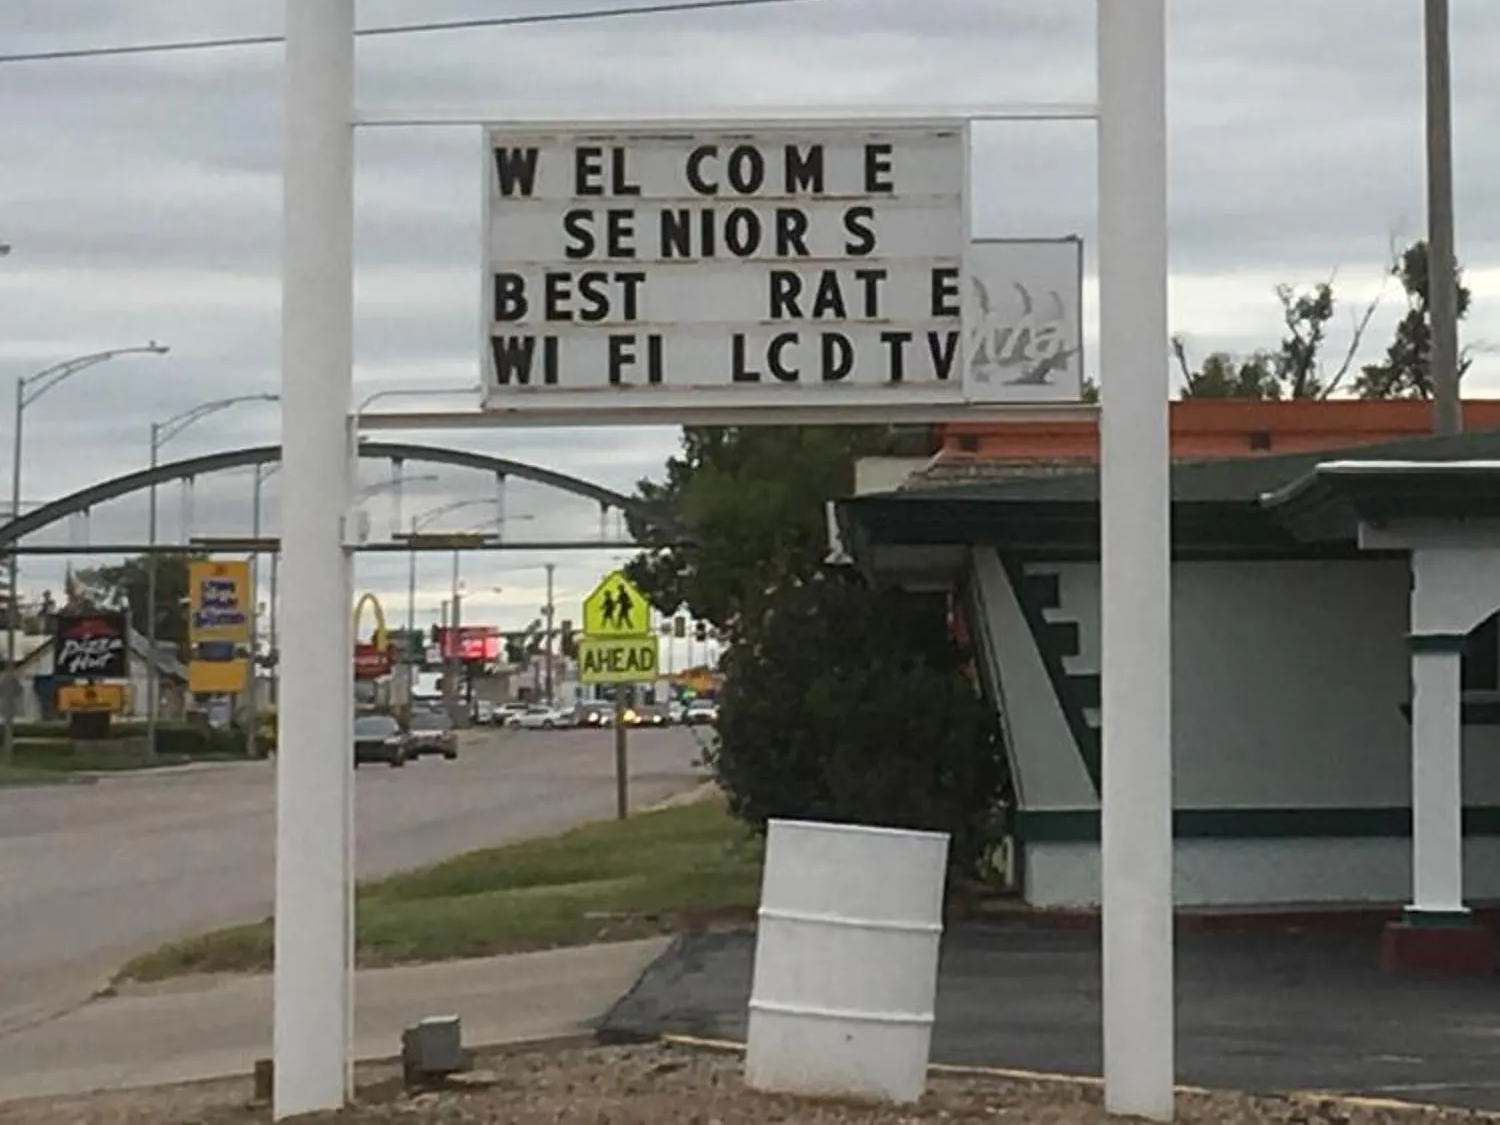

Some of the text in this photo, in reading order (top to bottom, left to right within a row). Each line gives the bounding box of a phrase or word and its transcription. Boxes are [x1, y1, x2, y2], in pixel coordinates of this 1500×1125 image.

[494, 143, 895, 196] WELCOME
[563, 206, 877, 259] SENIORS
[493, 267, 961, 323] BEST RATE
[582, 646, 656, 673] AHEAD
